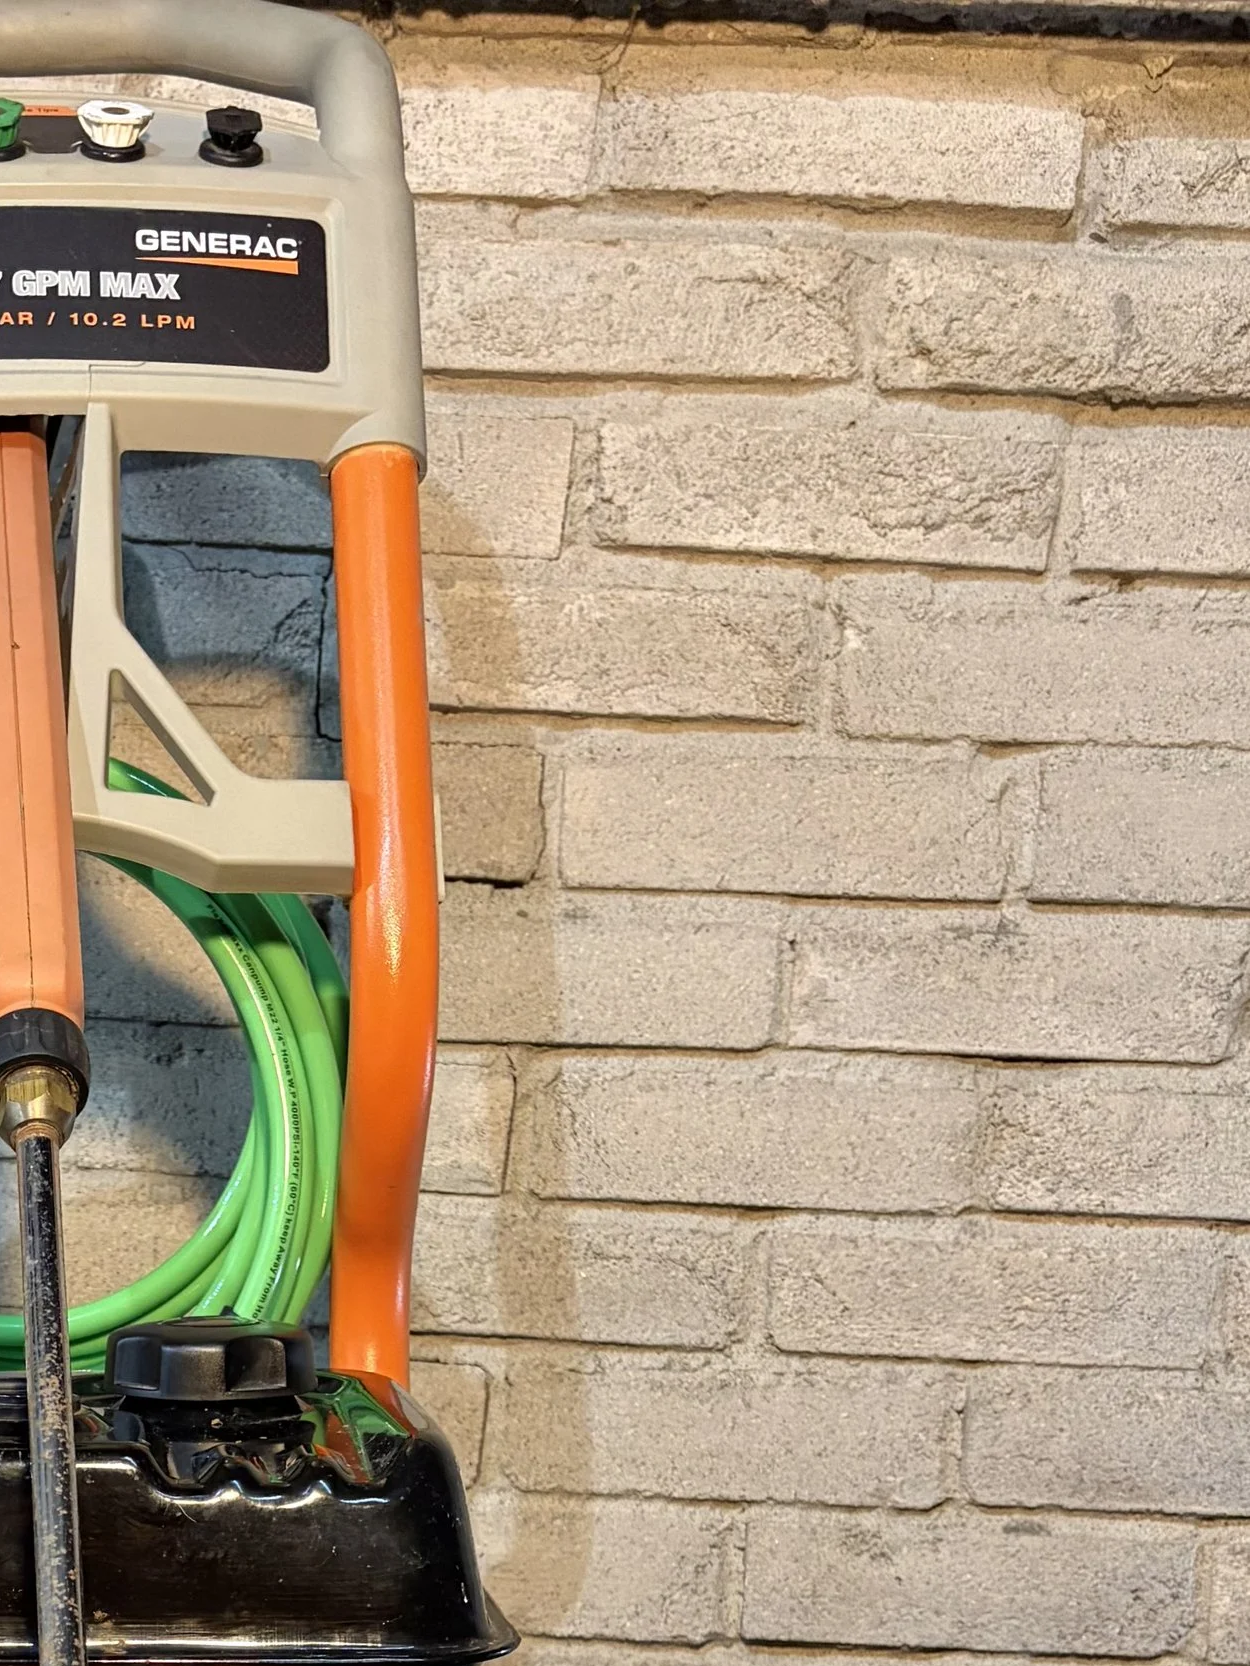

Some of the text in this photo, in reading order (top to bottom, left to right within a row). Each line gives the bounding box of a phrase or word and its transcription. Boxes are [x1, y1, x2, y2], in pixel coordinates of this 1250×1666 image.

[135, 228, 299, 260] GENERAC
[11, 269, 91, 298] GPM
[99, 271, 181, 300] MAX
[47, 311, 56, 327] /
[69, 312, 127, 328] 10.2
[141, 313, 196, 330] LPM
[242, 954, 269, 1002] Canpump
[266, 1003, 278, 1025] M22
[281, 1049, 291, 1076] Hose
[270, 1245, 285, 1273] Away
[252, 1305, 265, 1320] Ho
